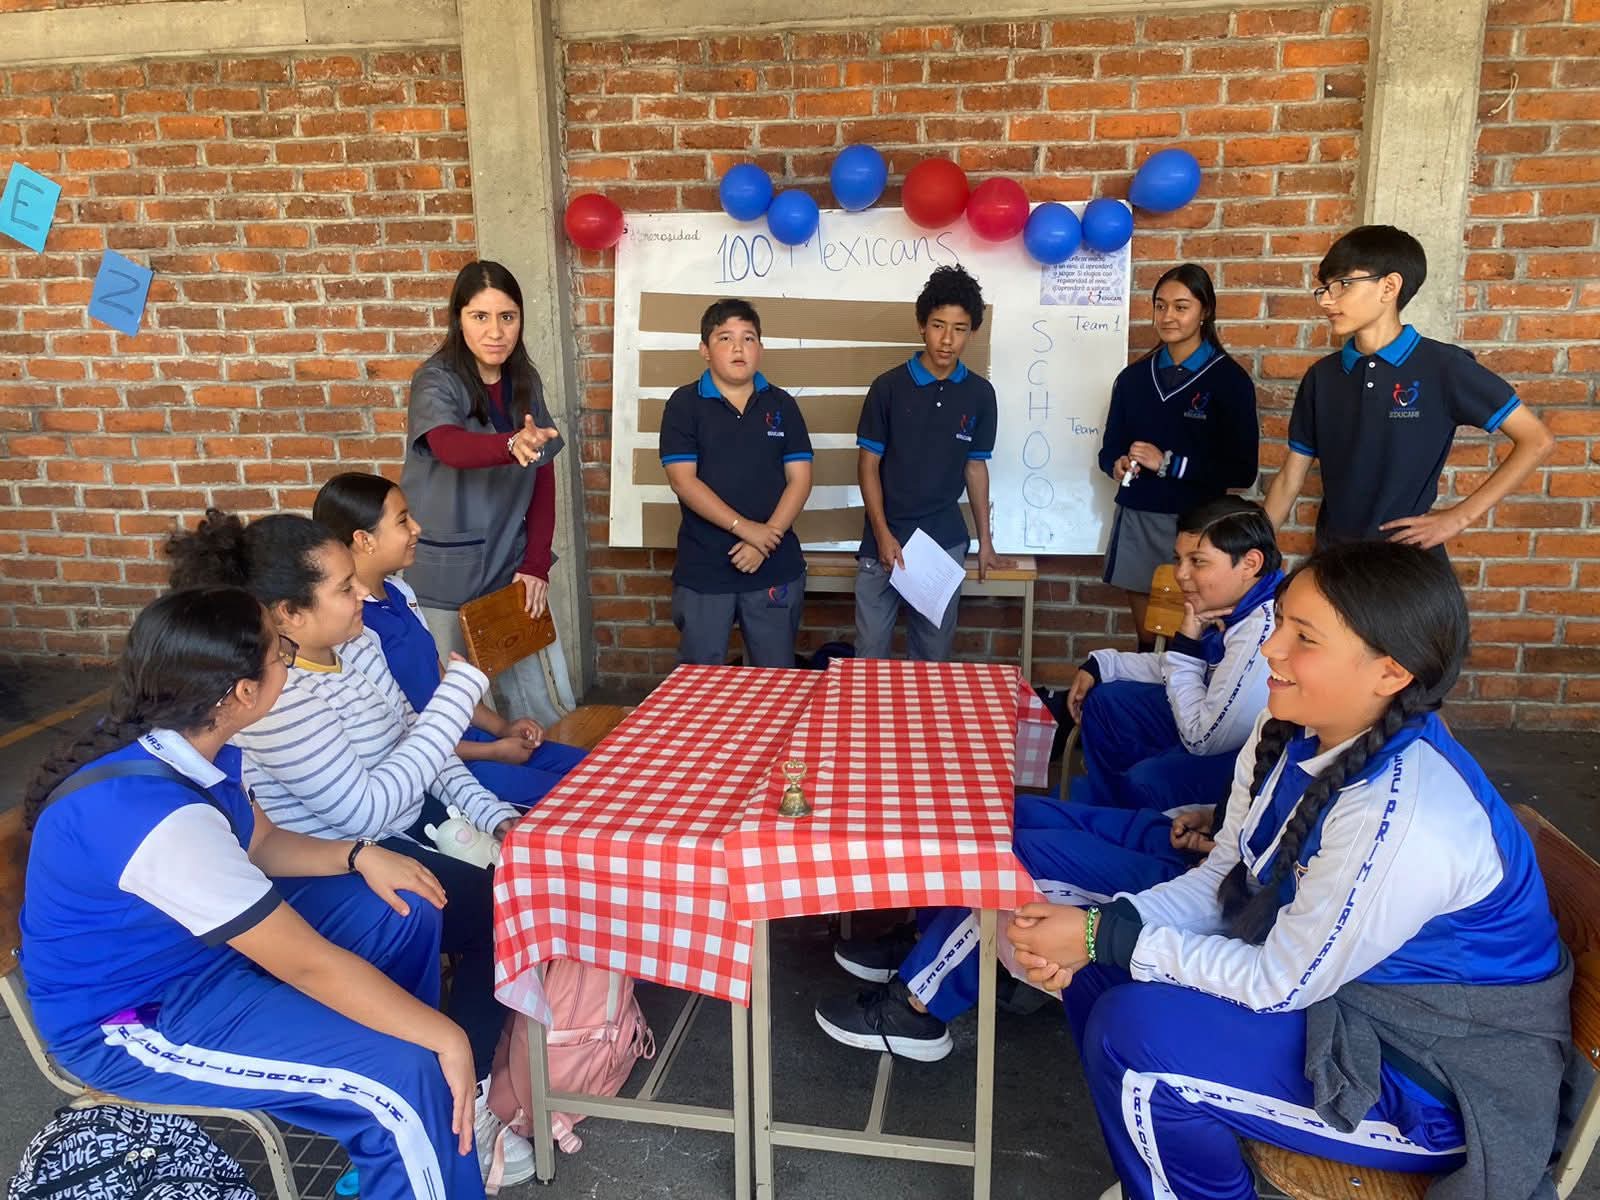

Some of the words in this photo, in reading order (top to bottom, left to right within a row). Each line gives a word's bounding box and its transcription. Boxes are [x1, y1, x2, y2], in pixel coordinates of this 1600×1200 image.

[10, 178, 45, 231] E
[714, 234, 774, 284] 100
[1067, 314, 1109, 331] Team
[1113, 314, 1121, 332] 1
[1063, 416, 1099, 435] Team
[1356, 799, 1397, 882] PRIM
[1299, 887, 1356, 986] LAZARO
[1255, 1104, 1325, 1129] RIM
